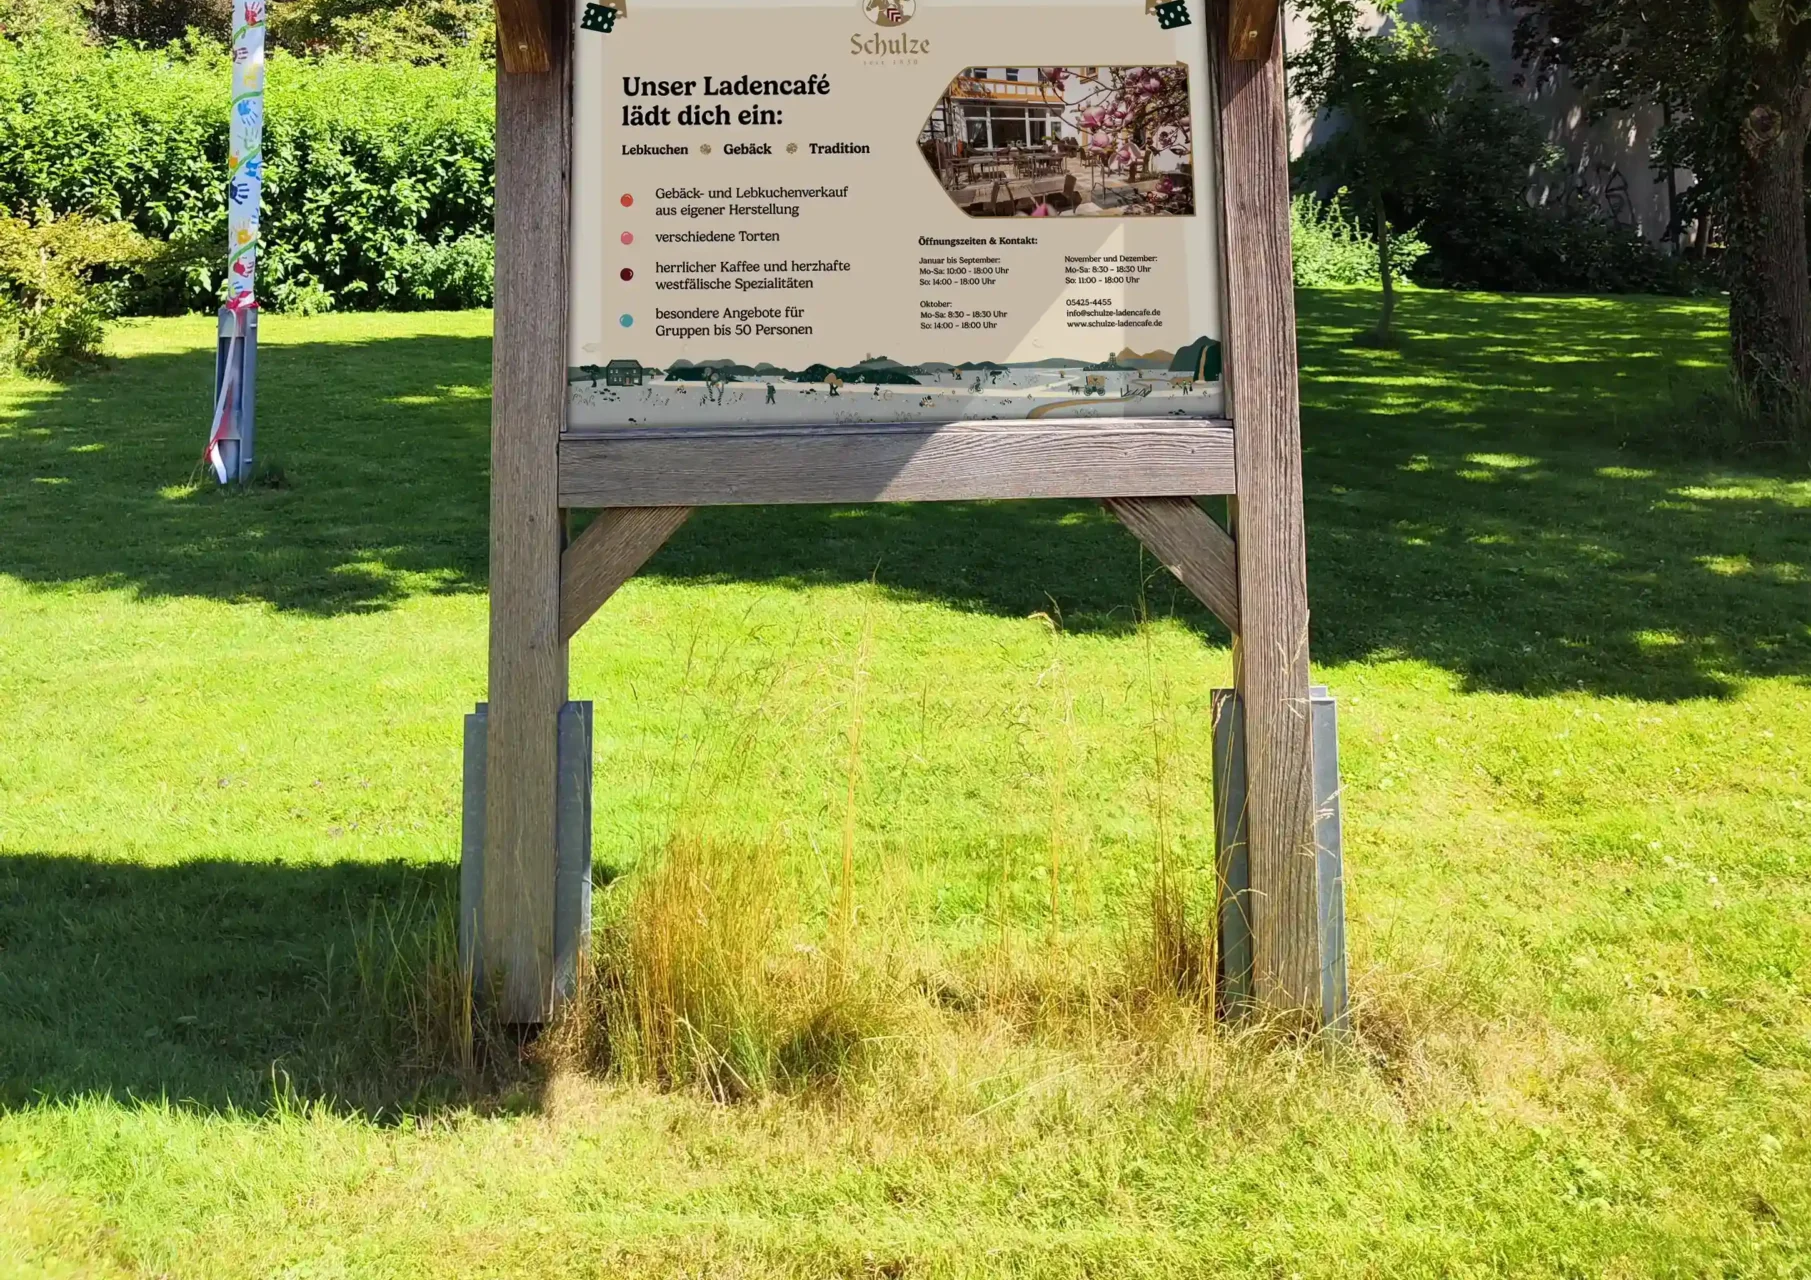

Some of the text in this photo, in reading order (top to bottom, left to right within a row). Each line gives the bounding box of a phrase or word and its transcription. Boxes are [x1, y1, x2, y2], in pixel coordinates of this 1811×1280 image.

[851, 32, 930, 56] Schulze
[622, 74, 830, 97] Unser Ladencafé
[622, 104, 783, 126] lädt dich ein:
[622, 142, 870, 155] Lebkuchen Gebäck Tradition
[656, 186, 848, 199] Gebäck- und Lebkuchenverkauf
[656, 204, 799, 218] aus eigener Herstellung
[656, 231, 780, 242] verschiedene Torten
[919, 236, 987, 247] Öffnungszeiten
[999, 236, 1038, 244] Kontakt:
[656, 260, 850, 273] herrlicher Kaffee und herzhafte
[959, 257, 1000, 265] September:
[656, 278, 813, 291] westfälische Spezialitäten
[919, 278, 930, 286] So:
[656, 307, 804, 321] besondere Angebote für
[656, 324, 812, 338] Gruppen bis 50 Personen
